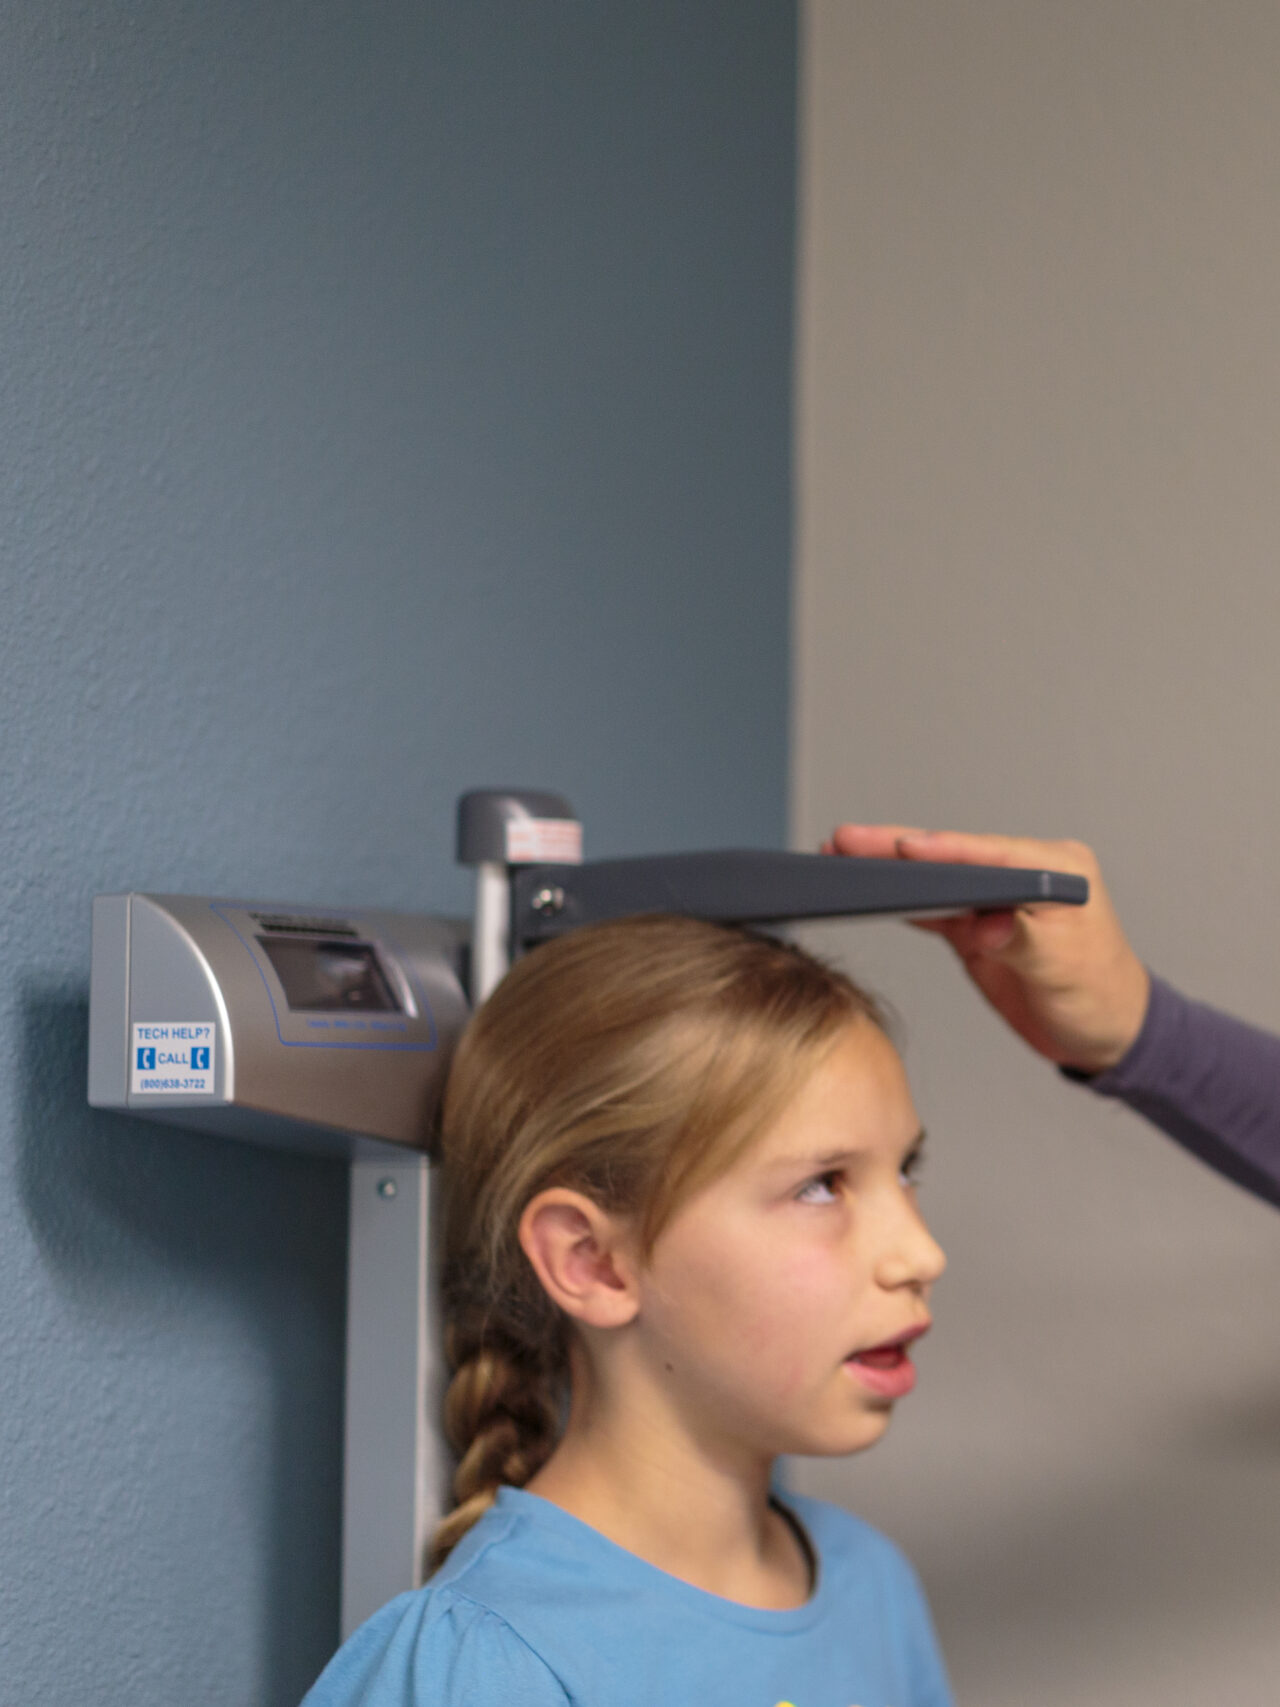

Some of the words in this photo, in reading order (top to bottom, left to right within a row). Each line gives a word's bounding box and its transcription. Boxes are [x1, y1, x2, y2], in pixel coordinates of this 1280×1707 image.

[137, 1027, 168, 1040] TECH
[171, 1027, 211, 1040] HELP?
[158, 1052, 189, 1065] CALL
[140, 1078, 206, 1091] (800)638-3722
